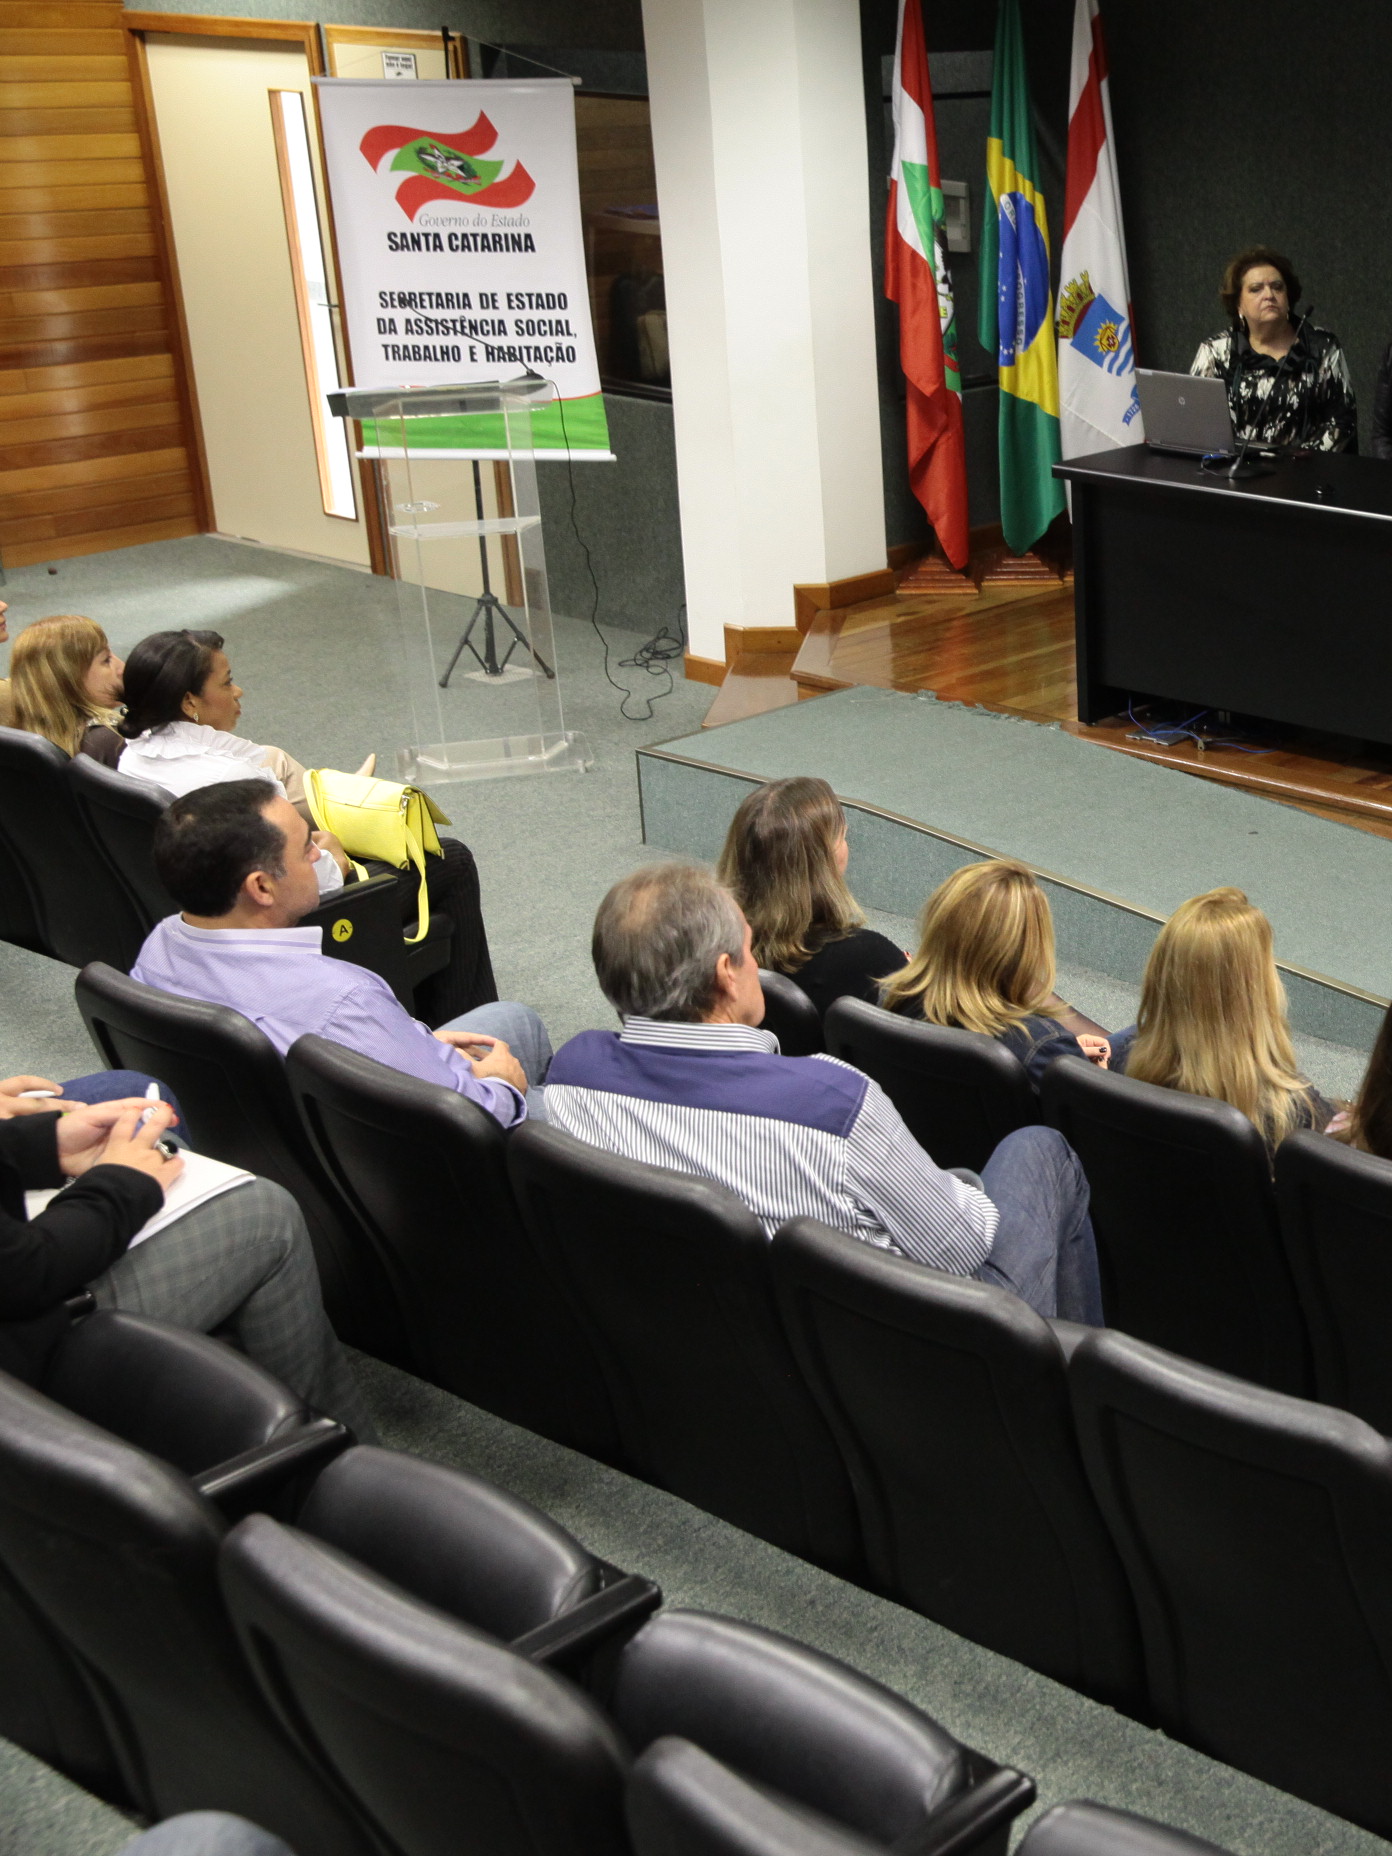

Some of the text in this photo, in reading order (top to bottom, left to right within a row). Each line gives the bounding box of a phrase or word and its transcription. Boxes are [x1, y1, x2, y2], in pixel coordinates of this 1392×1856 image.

[419, 213, 530, 228] Governo do Estado
[387, 231, 536, 252] SANTA CATARINA
[379, 291, 568, 310] SECRETARIA DE ESTADO
[376, 315, 577, 338] DA ASSISTÊNCIA SOCIAL,
[382, 342, 576, 366] TRABALHO E HABITAÇÃO
[339, 924, 349, 937] A
